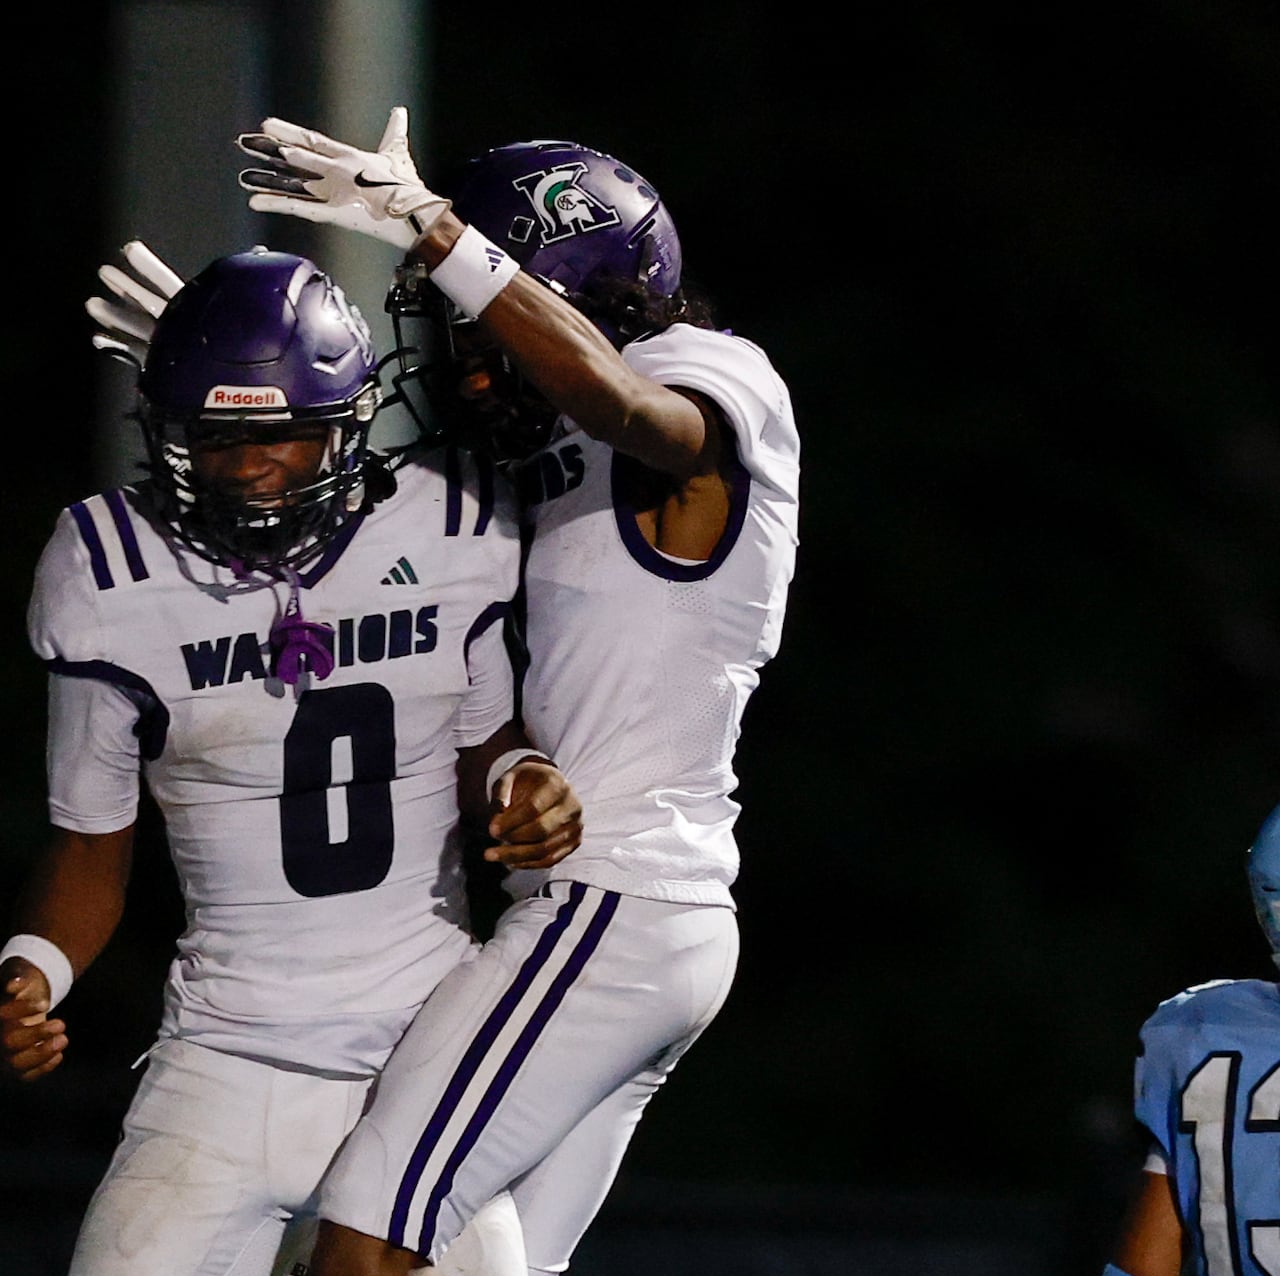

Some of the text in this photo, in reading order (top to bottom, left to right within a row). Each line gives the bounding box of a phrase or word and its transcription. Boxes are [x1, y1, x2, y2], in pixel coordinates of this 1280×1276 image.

[214, 391, 276, 405] Riddell
[180, 604, 439, 690] WAIORS
[280, 682, 395, 897] 0
